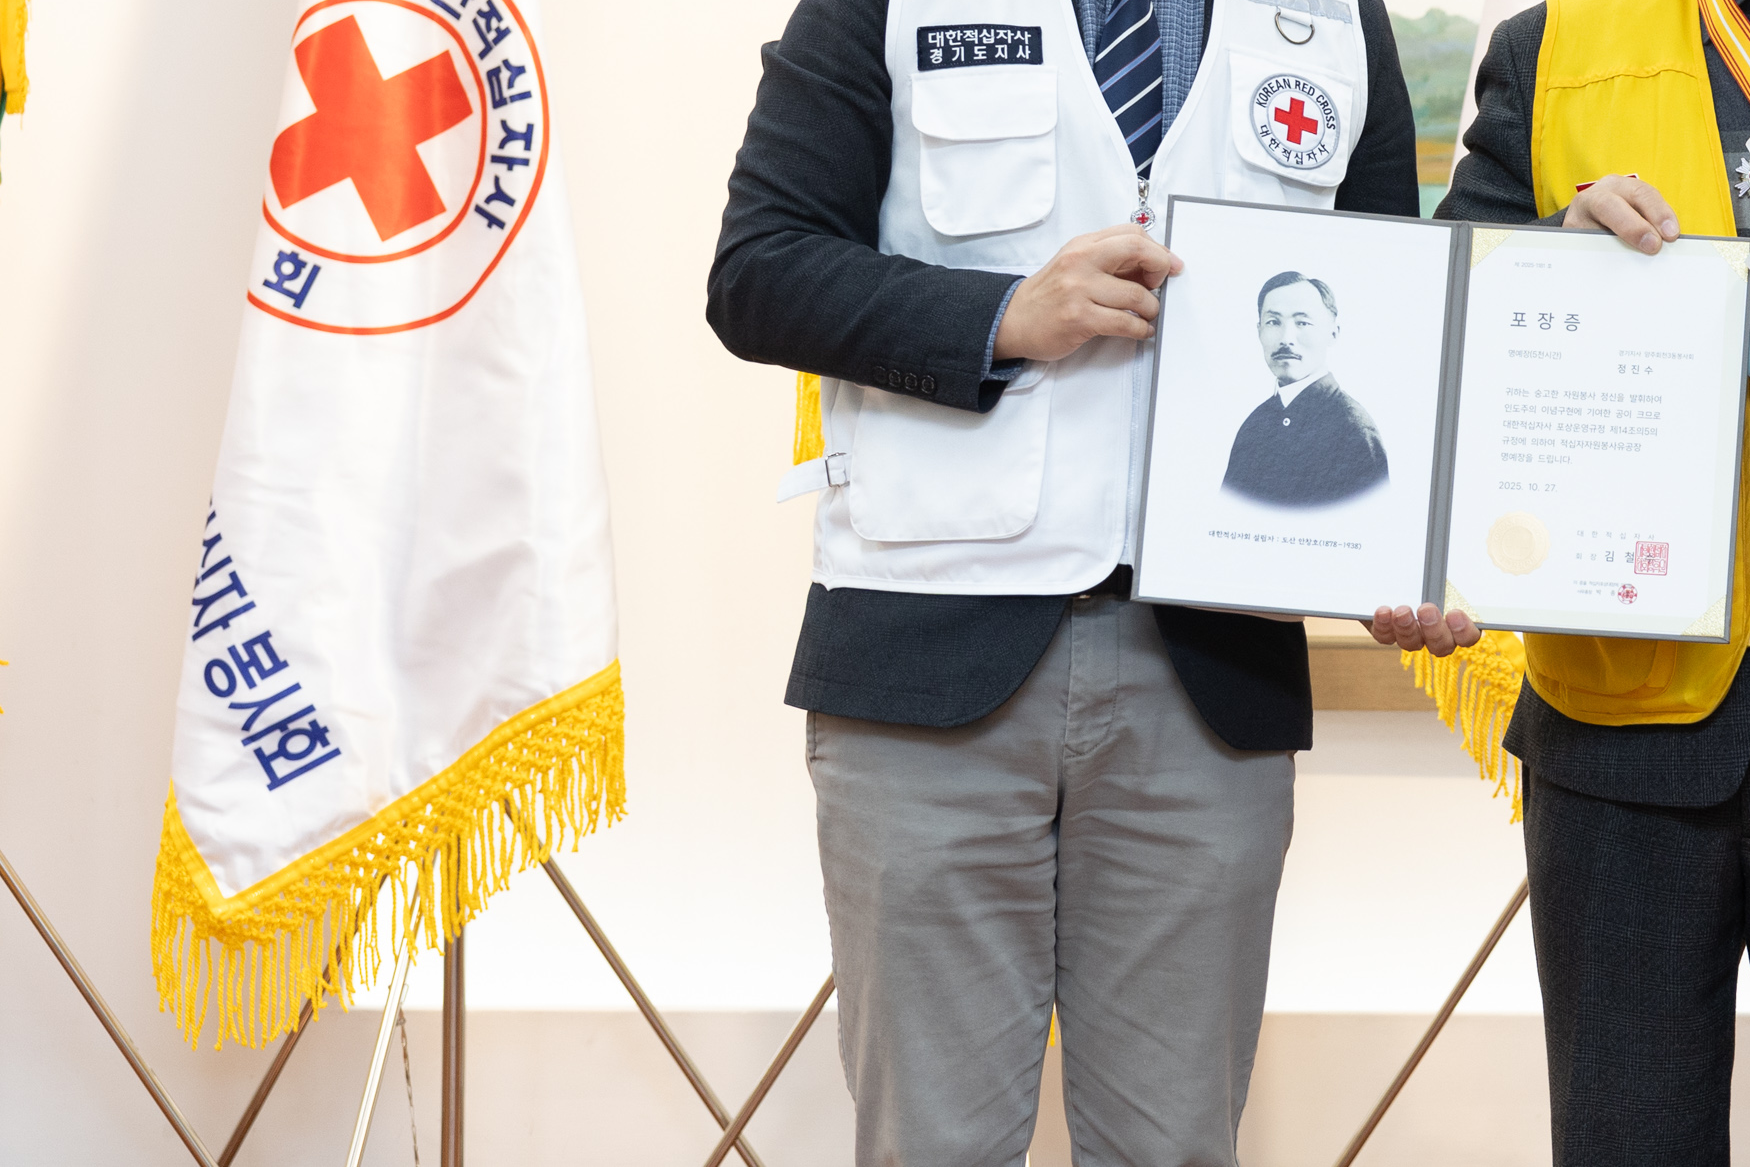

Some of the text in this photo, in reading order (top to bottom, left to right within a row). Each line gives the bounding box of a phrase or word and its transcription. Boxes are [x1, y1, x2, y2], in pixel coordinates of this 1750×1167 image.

[928, 29, 1032, 48] 대한적십자사
[929, 44, 1032, 64] 경기도지사
[1256, 78, 1336, 130] KOREAN RED CROSS
[1260, 124, 1330, 165] 대한적십자사
[262, 249, 321, 310] 회
[1505, 387, 1662, 404] 귀하는 숭고한 자원봉사 정신을 발휘하여
[1504, 403, 1661, 420] 인도주의 이념구현에 기여한 공이 크므로
[1502, 419, 1658, 437] 대한적십자사 포상운영규정 제14조의5의
[1501, 435, 1642, 453] 규정에 의하여 적십자자원봉사유공장
[1500, 452, 1573, 465] 명예장을 드립니다.
[1498, 480, 1558, 493] 2025. 10. 27.
[1208, 530, 1251, 540] 대한적십자회
[1254, 533, 1275, 543] 설립자
